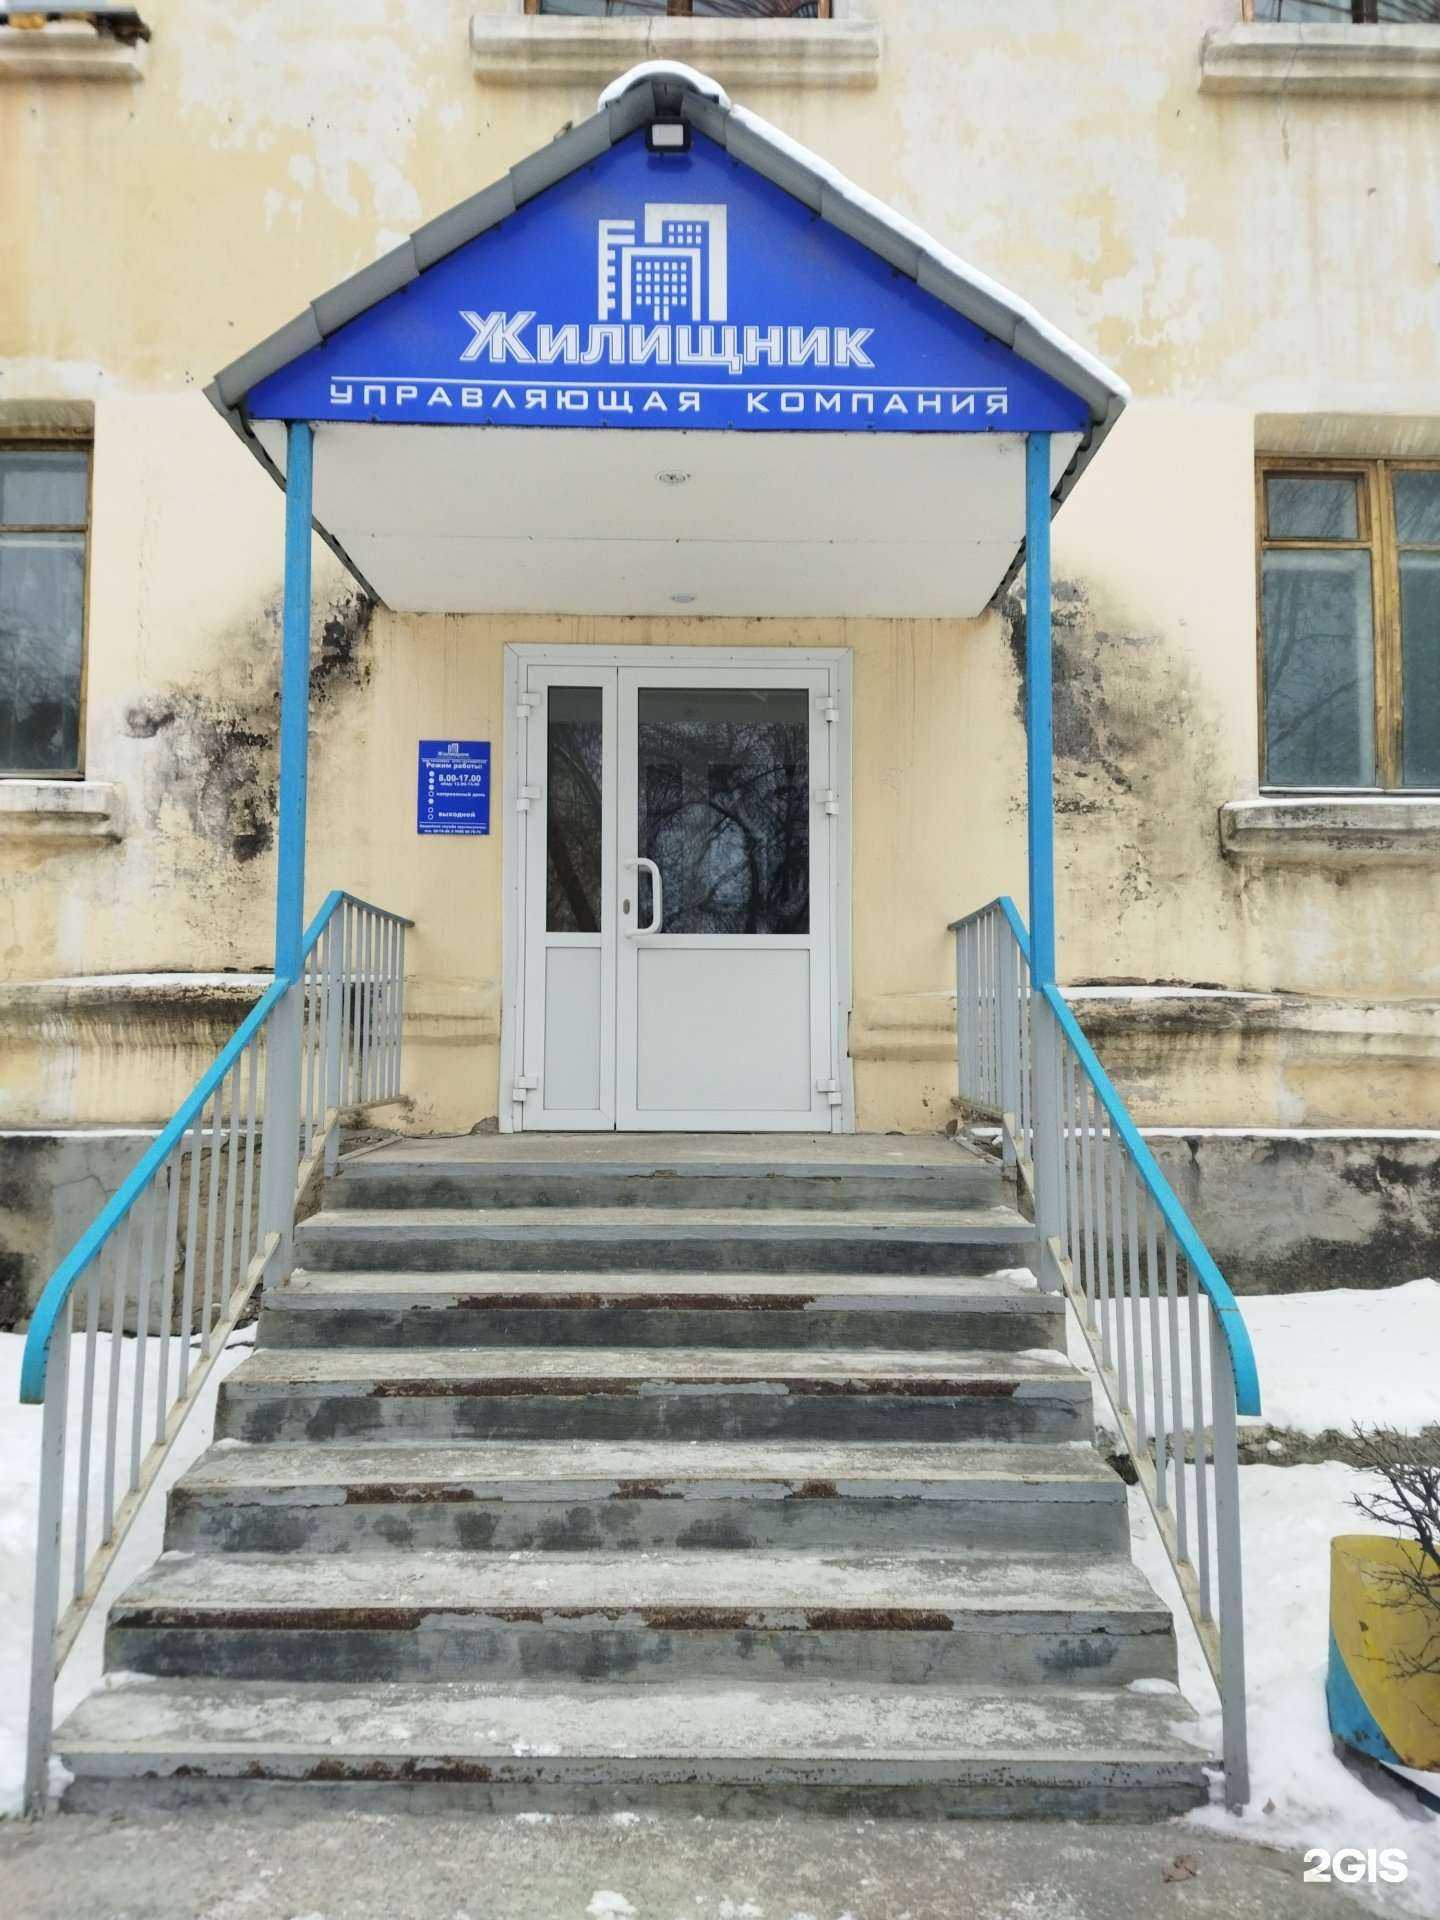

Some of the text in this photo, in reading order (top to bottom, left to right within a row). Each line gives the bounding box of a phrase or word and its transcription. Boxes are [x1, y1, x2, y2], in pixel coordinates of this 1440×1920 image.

[330, 384, 1009, 414] УПРАВЛЯЮЩАЯ КОМПАНИЯ
[438, 774, 482, 782] 8.00-17.00
